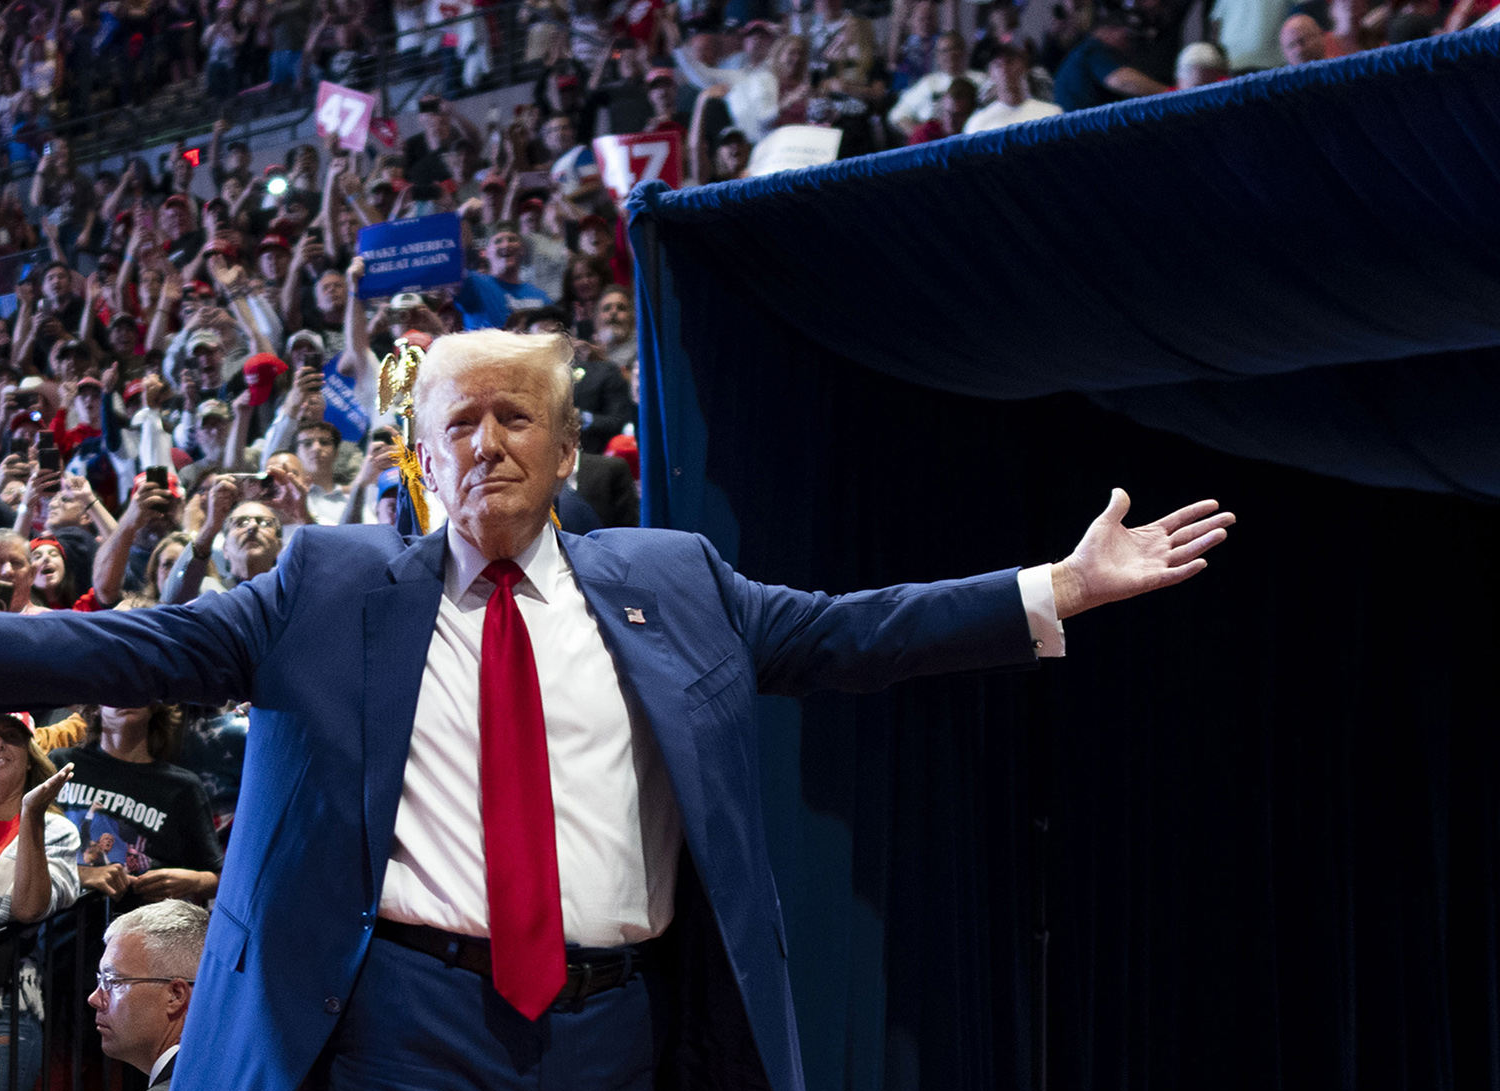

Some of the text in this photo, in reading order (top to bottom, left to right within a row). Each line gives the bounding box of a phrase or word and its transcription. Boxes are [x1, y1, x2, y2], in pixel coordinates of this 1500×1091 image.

[318, 93, 367, 137] 47
[363, 238, 456, 261] MAKE AMERICA
[368, 253, 450, 275] GREAT AGAIN
[56, 781, 167, 833] BULLETPROOF
